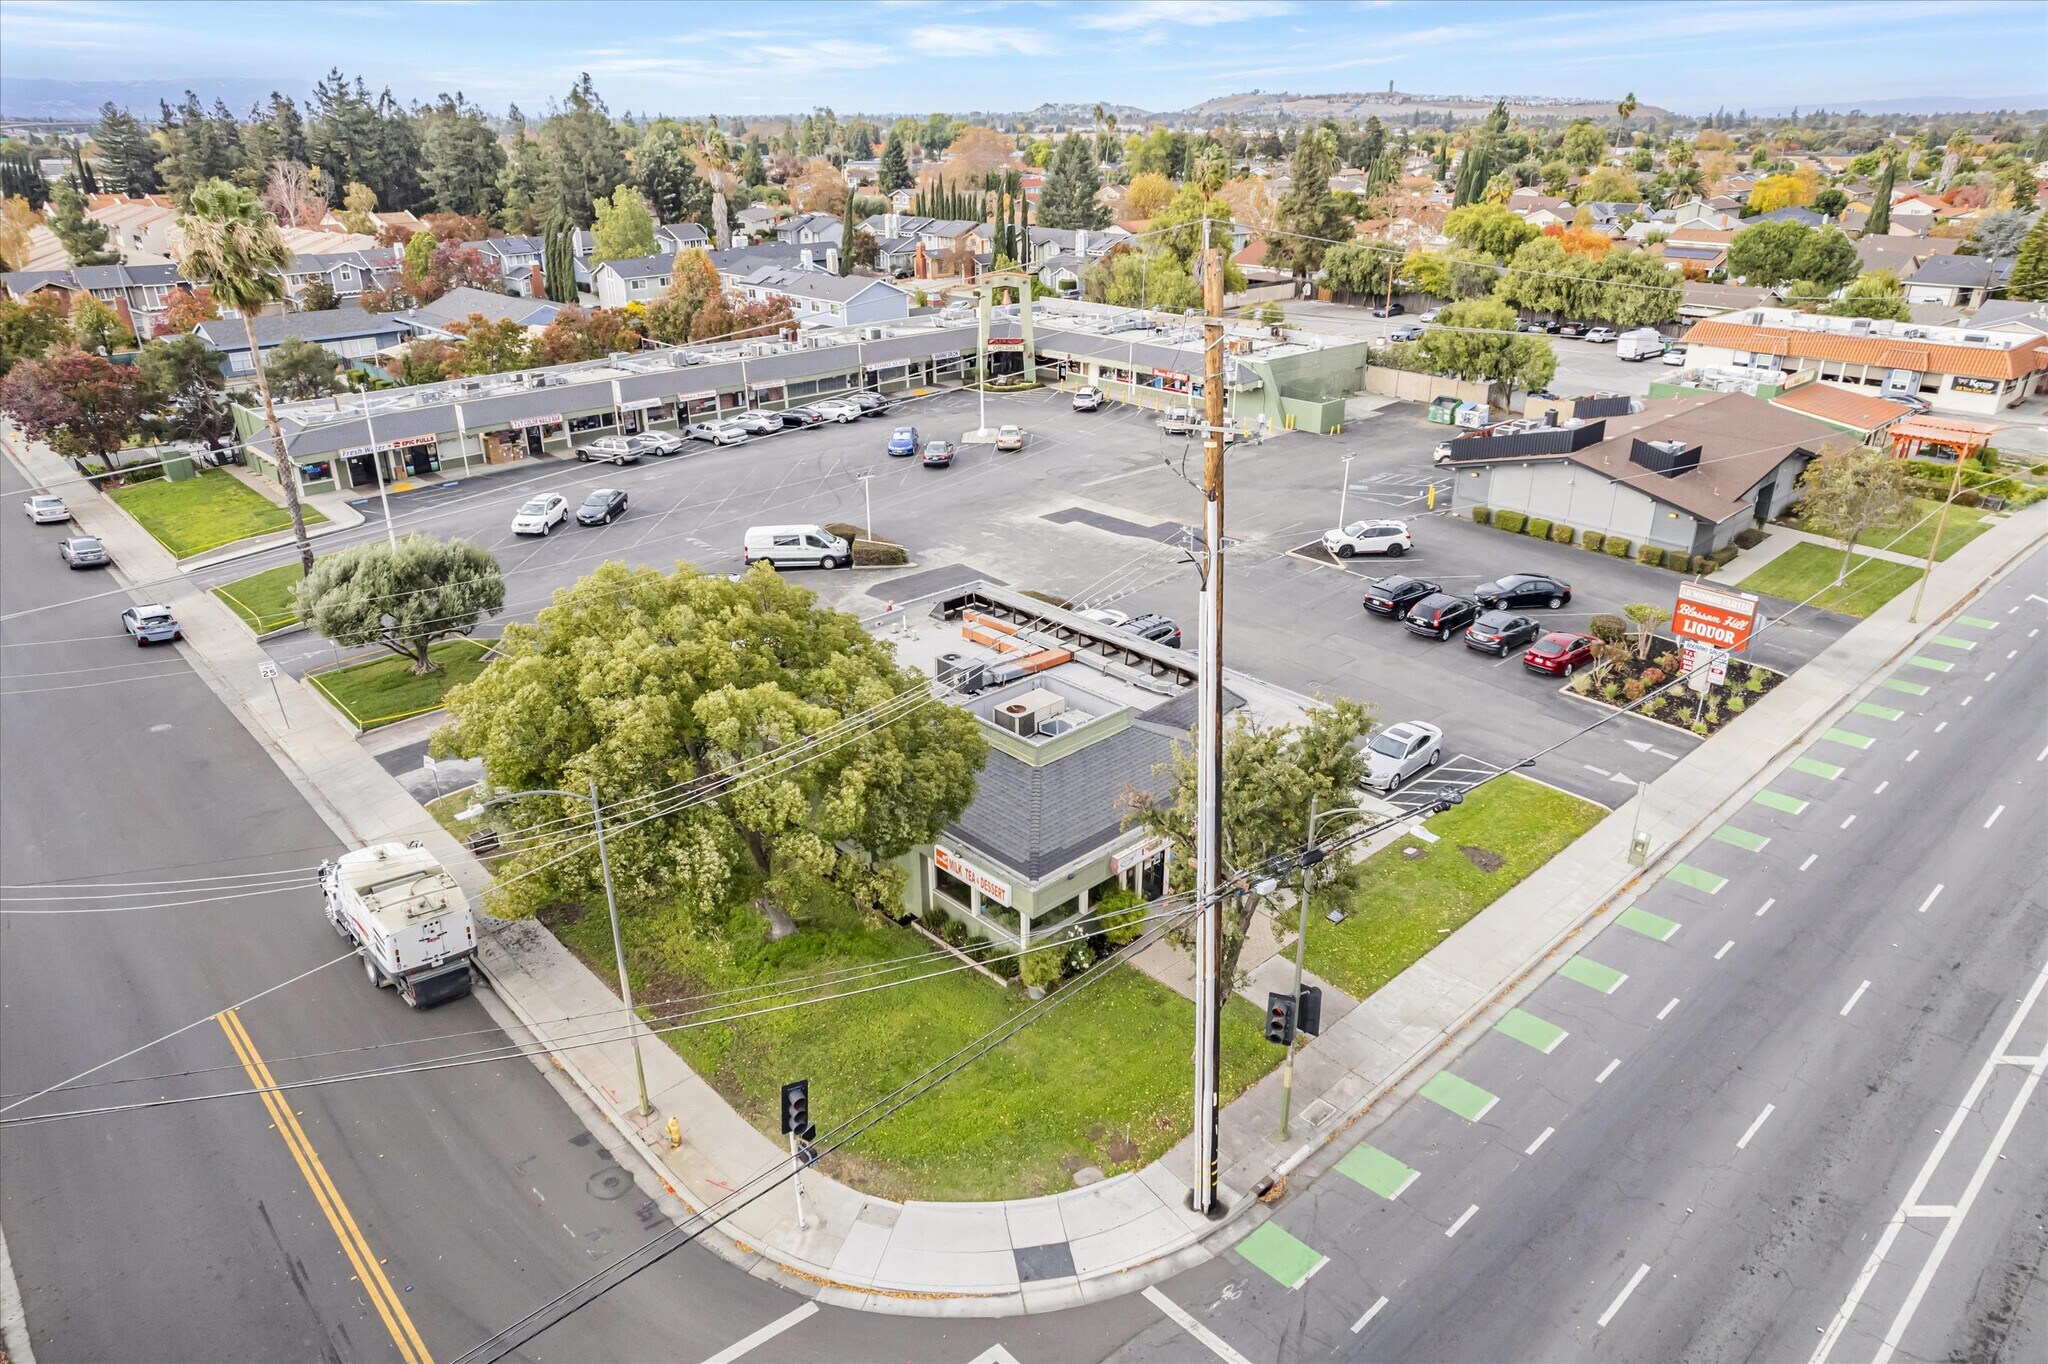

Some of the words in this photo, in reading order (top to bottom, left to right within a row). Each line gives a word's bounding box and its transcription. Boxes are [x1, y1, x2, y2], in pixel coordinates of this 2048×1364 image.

[401, 439, 415, 447] EPIC
[415, 436, 435, 444] PULLS
[342, 447, 363, 457] Fresh
[1677, 603, 1722, 624] Blossom
[1722, 615, 1750, 631] Hill
[1683, 619, 1736, 645] LIQUOR
[262, 669, 277, 678] 25
[948, 857, 962, 875] MILK
[965, 867, 976, 885] TEA
[980, 876, 1006, 901] DESSERT
